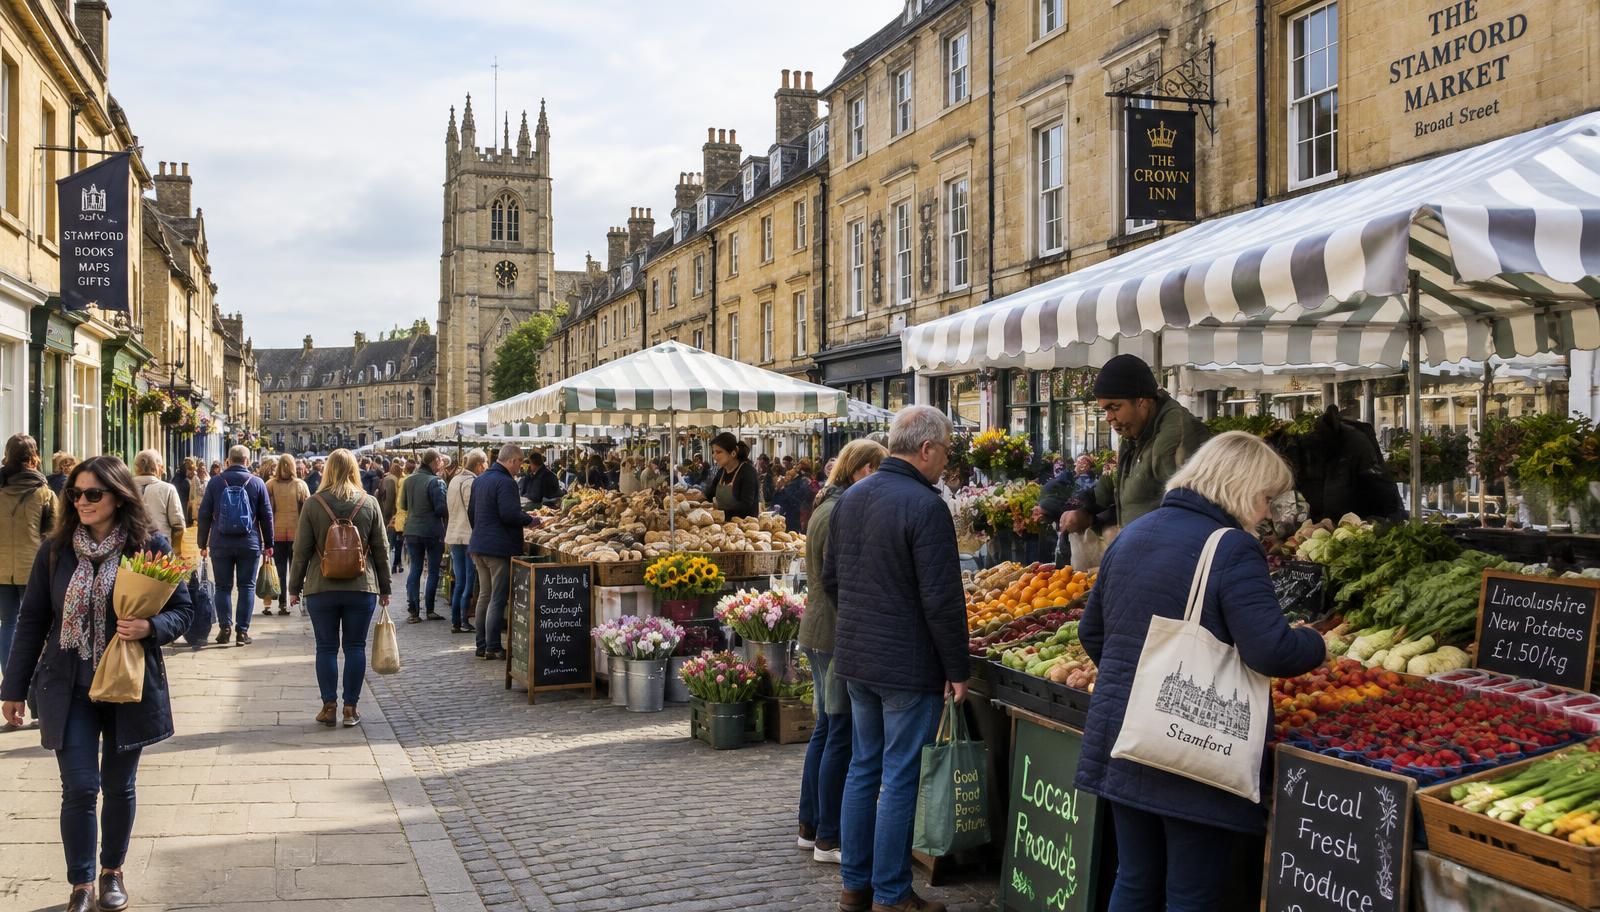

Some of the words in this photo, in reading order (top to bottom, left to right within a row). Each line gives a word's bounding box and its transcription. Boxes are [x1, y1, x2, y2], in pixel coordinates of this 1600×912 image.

[1428, 0, 1478, 36] THE
[1389, 13, 1527, 85] STAMFORD
[1404, 54, 1510, 113] MARKET
[1414, 111, 1454, 137] Broad
[1459, 99, 1500, 124] Sreet
[1148, 154, 1176, 167] THE
[1134, 168, 1190, 184] CROWN
[1148, 187, 1177, 200] INN
[74, 246, 114, 257] BOOKS
[79, 262, 110, 273] MAPS
[78, 276, 111, 287] GIFTS
[1488, 611, 1519, 632] New
[1491, 638, 1568, 675] £1.50/kg
[1166, 723, 1233, 756] Stamford
[955, 786, 980, 802] Food
[1279, 851, 1374, 912] Produce
